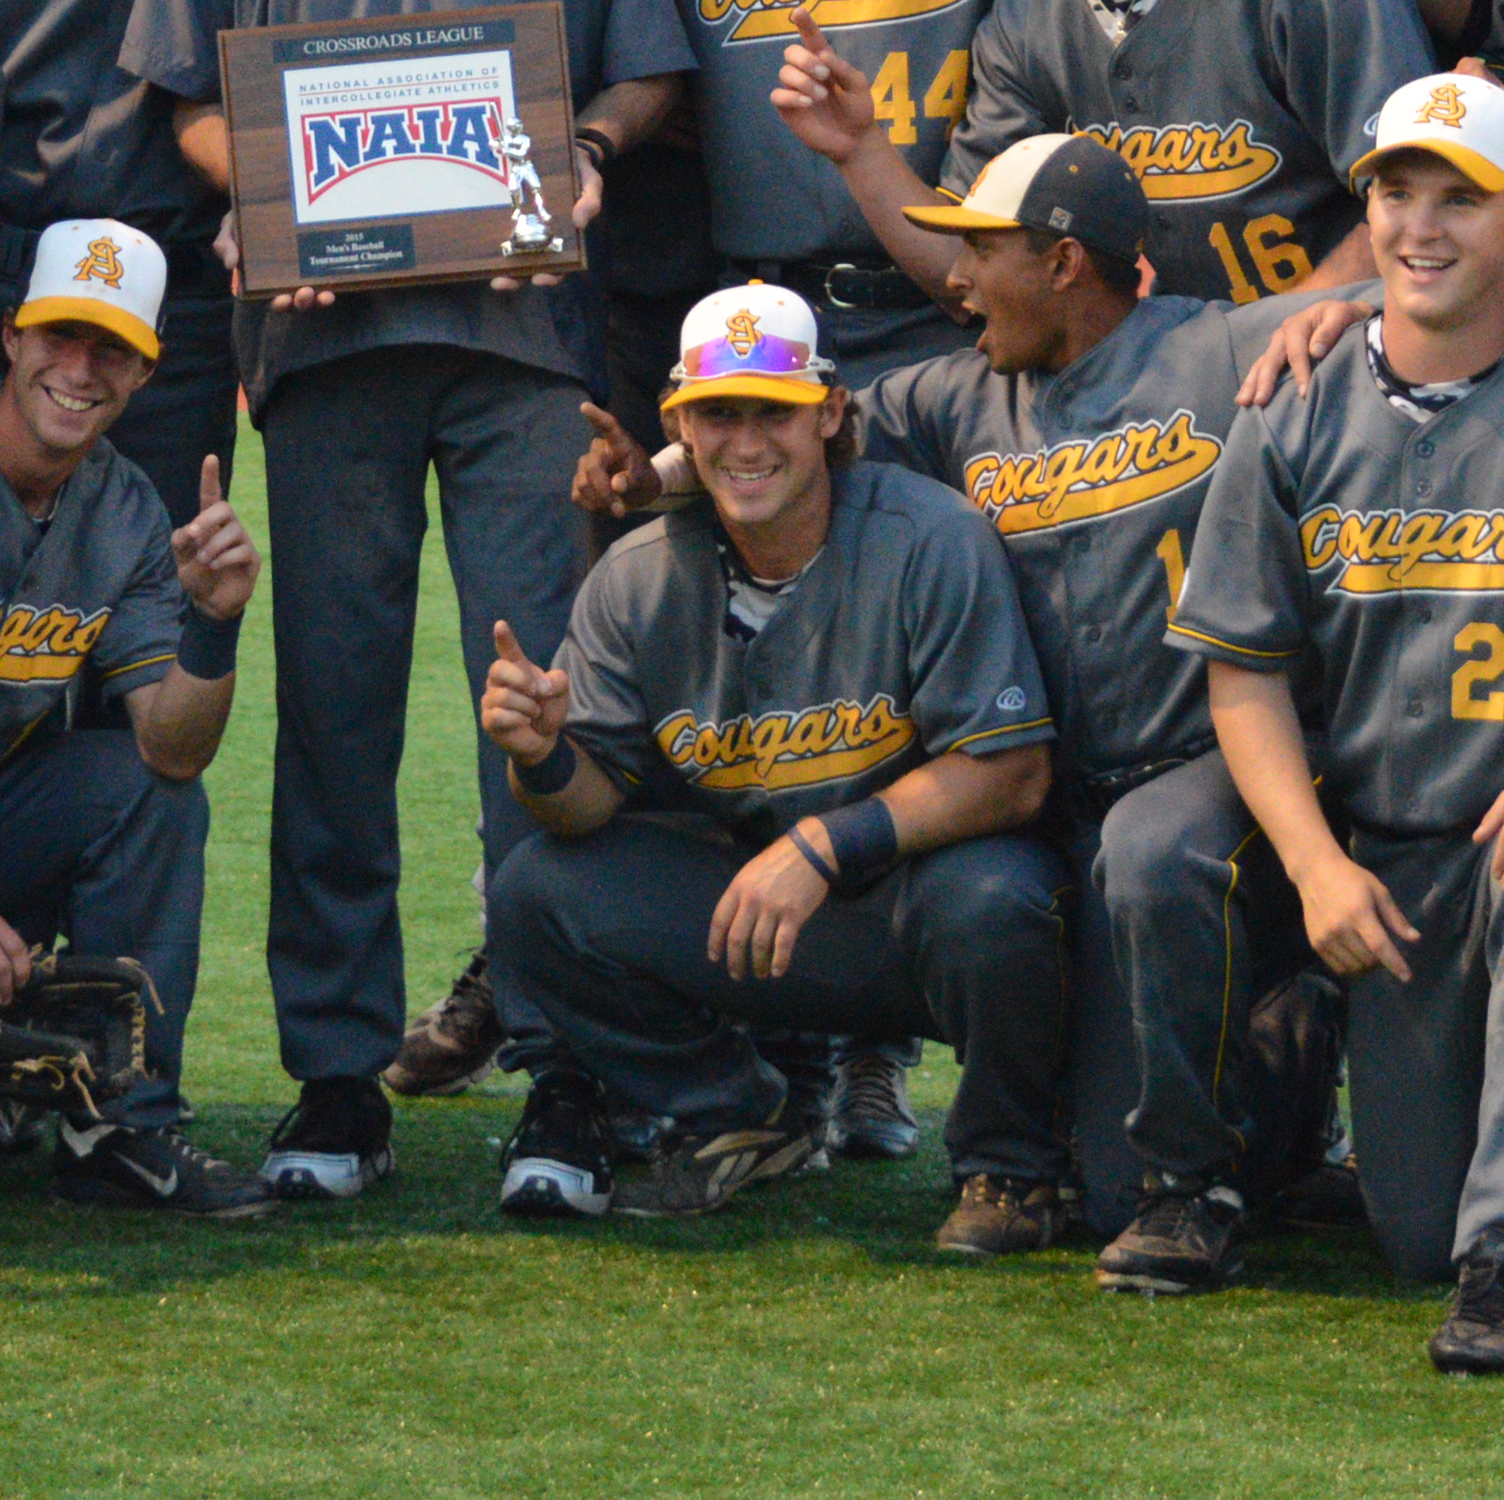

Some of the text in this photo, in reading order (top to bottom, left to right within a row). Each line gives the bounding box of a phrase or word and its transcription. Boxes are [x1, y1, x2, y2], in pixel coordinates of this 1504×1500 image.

[303, 26, 484, 55] CROSSROADS LEAGUE
[299, 66, 498, 92] NATIONAL ASSOCIATION OF
[300, 80, 500, 106] INTERCOLLEGIATE ATHLETICS
[307, 104, 503, 190] NAIA
[1208, 213, 1313, 304] 16
[654, 692, 908, 778] Cougars
